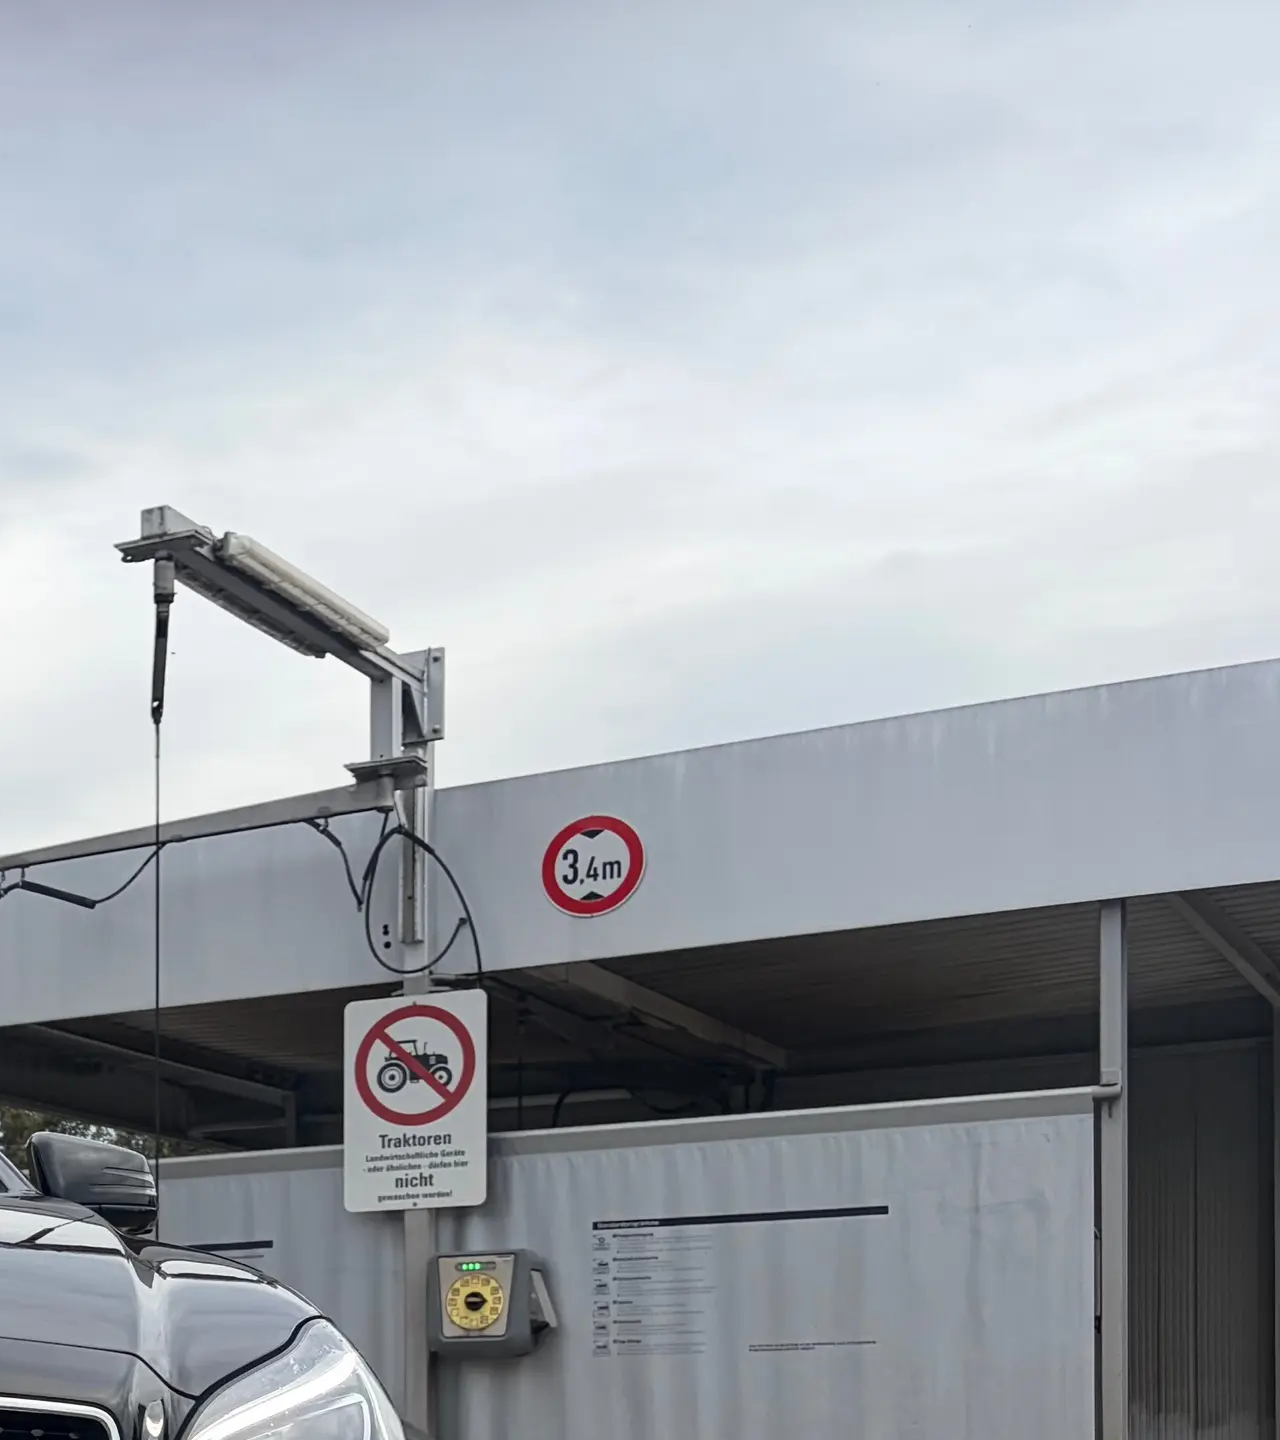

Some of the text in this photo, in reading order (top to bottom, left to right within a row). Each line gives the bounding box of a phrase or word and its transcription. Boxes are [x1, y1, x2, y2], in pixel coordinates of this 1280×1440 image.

[561, 847, 622, 886] 3,4m
[378, 1133, 452, 1149] Traktoren
[365, 1149, 466, 1162] Landwirtschaftliche Geräte
[453, 1159, 469, 1168] hier
[395, 1172, 434, 1188] nicht
[378, 1192, 420, 1203] gewaschen
